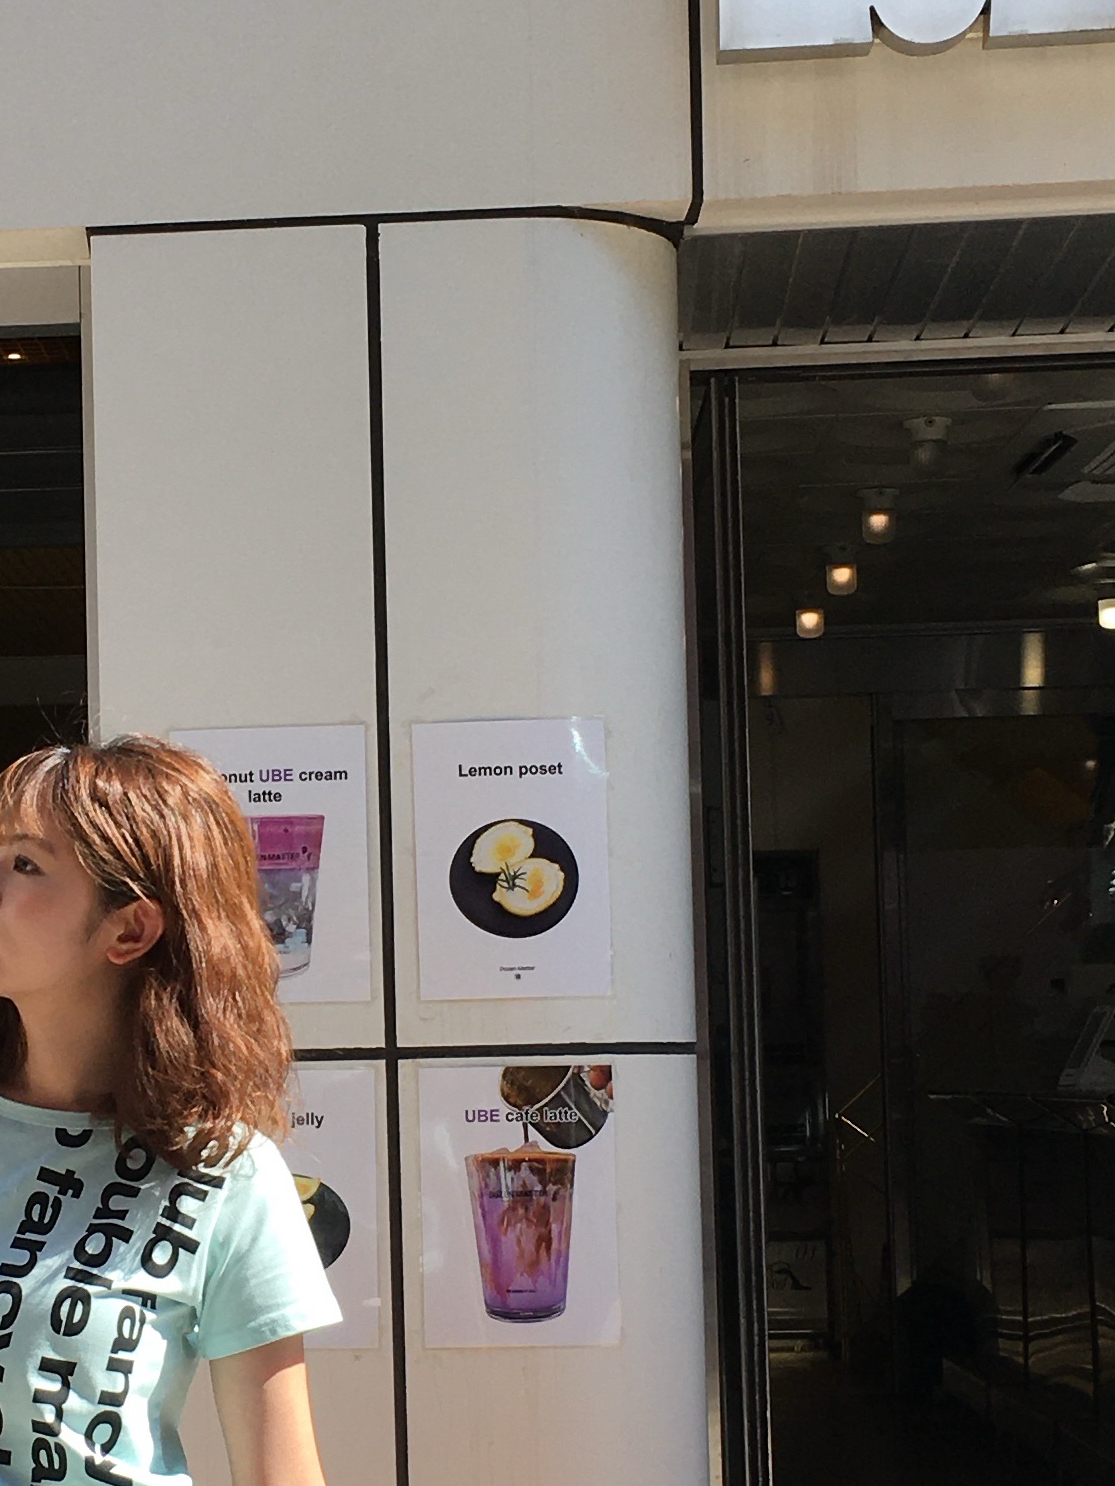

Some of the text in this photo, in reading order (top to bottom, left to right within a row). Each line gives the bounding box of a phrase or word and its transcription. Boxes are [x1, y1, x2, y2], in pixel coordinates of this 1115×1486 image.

[259, 769, 294, 782] UBE
[299, 770, 348, 782] cream
[458, 762, 563, 779] Lemon poset
[248, 789, 283, 803] latte
[291, 1112, 324, 1129] jelly
[465, 1109, 500, 1123] UBE
[544, 1107, 578, 1122] latte
[140, 1166, 226, 1280] lub
[50, 1136, 155, 1338] ouble
